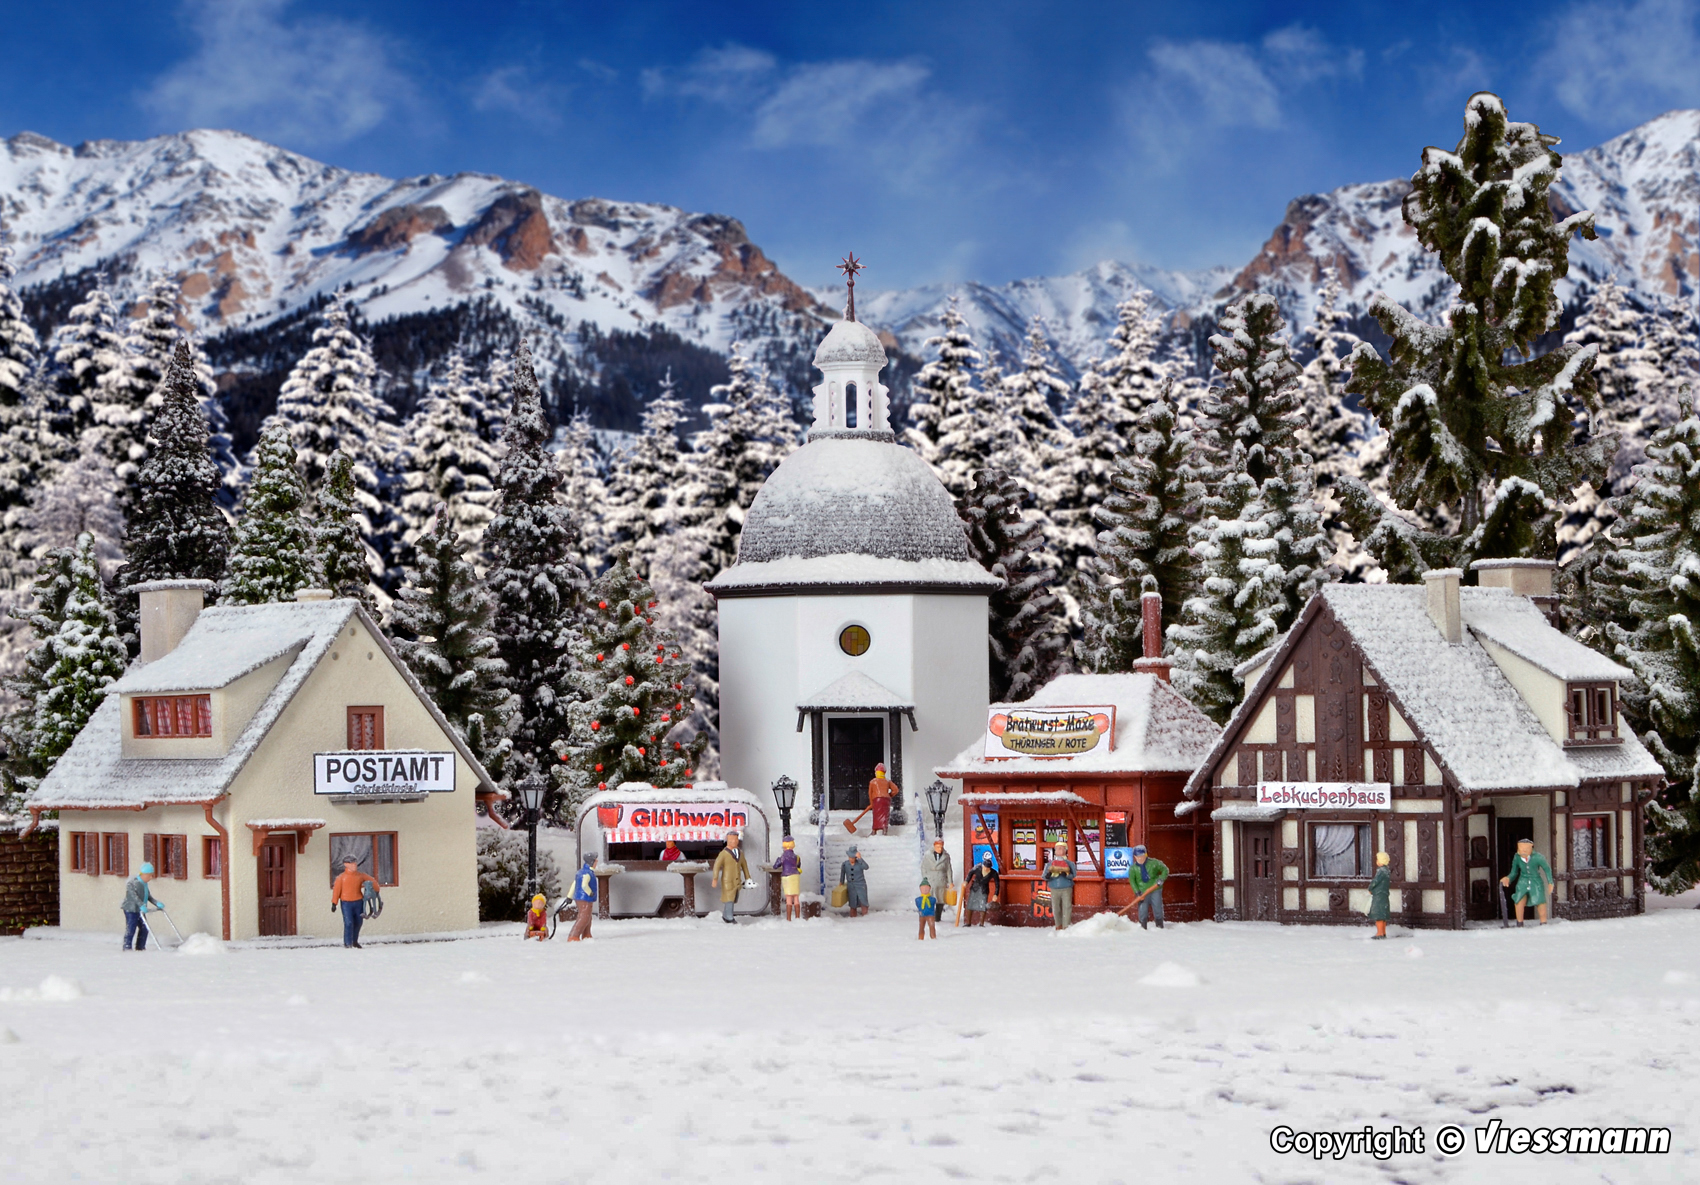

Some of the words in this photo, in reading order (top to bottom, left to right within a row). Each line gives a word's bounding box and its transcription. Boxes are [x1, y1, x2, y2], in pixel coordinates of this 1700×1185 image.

[1010, 738, 1055, 749] THÜRINGER
[1065, 738, 1087, 748] ROTE
[326, 757, 444, 783] POSTAMT
[1260, 786, 1385, 807] Lebkuchenhaus
[630, 808, 746, 828] Glühwein
